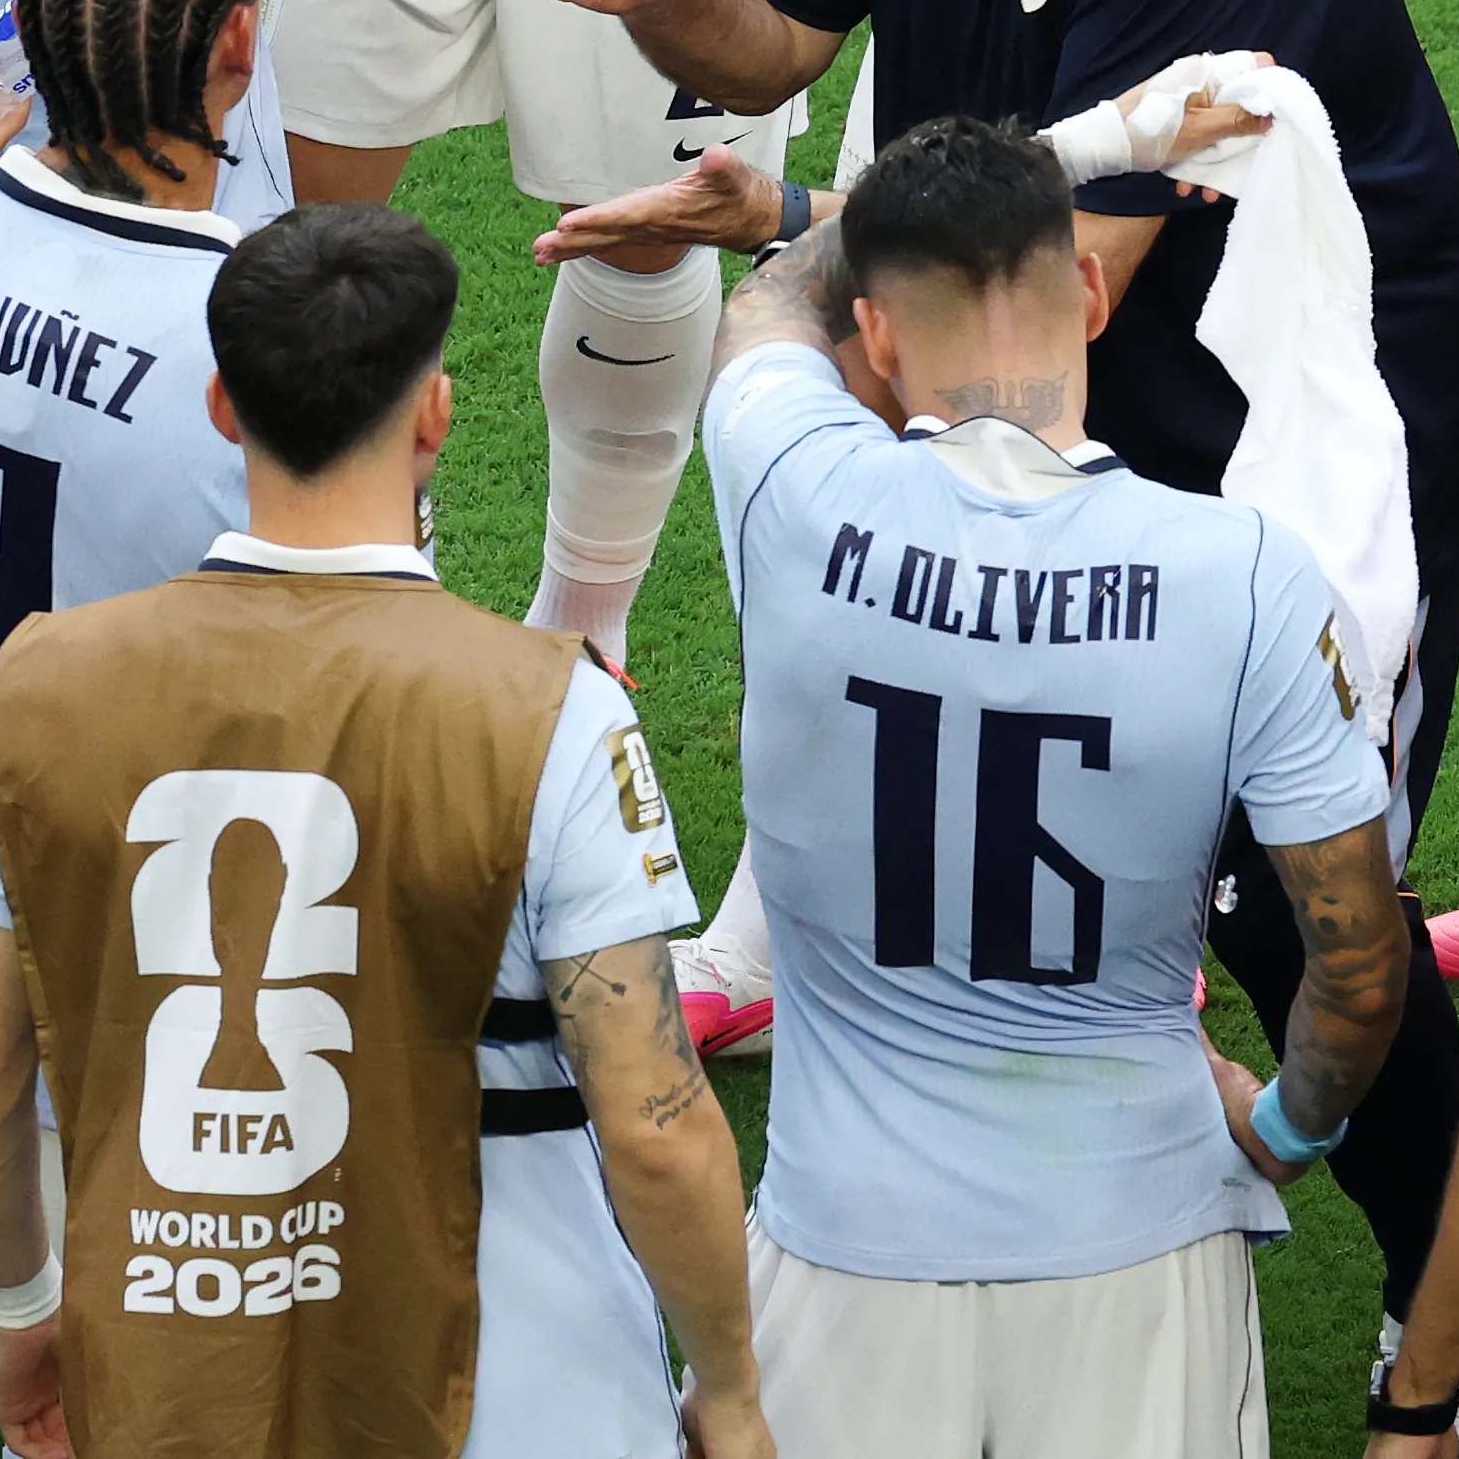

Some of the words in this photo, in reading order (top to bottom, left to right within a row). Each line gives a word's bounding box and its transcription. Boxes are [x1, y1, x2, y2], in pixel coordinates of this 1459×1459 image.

[821, 522, 876, 610] M.
[891, 543, 1160, 645] OLIVERA
[845, 676, 1112, 986] 16
[191, 1111, 295, 1155] FIFA
[130, 1207, 271, 1250] WORLD
[279, 1200, 346, 1246] CUP
[123, 1243, 342, 1318] 2026
